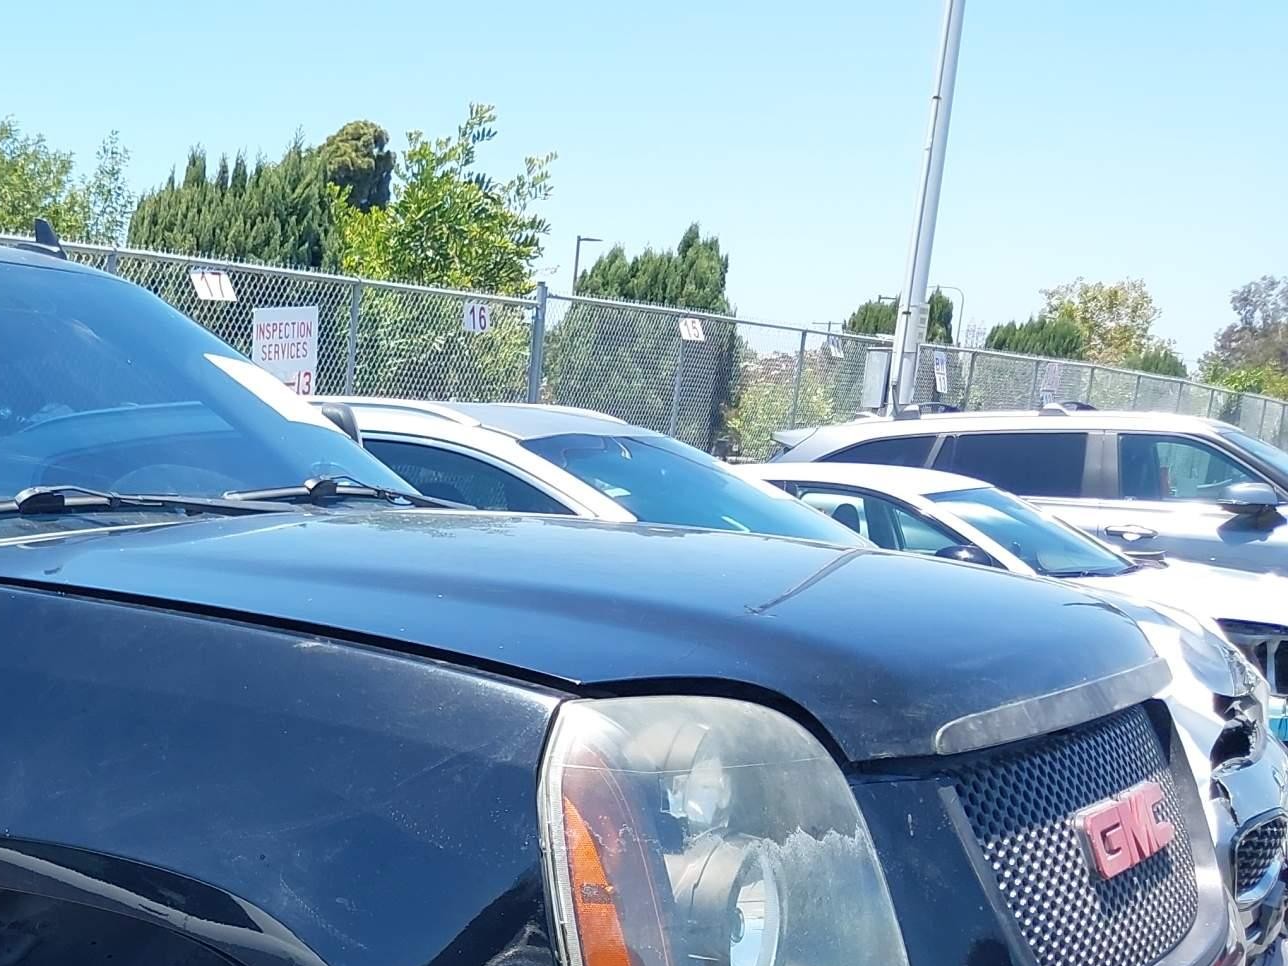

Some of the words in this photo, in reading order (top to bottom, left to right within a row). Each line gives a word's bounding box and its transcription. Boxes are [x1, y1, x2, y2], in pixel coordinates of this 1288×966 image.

[200, 271, 225, 299] 17
[469, 305, 487, 330] 16
[255, 321, 312, 340] INSPECTION
[684, 320, 699, 338] 15
[261, 341, 308, 361] SERVICES
[1074, 781, 1175, 879] GMC
